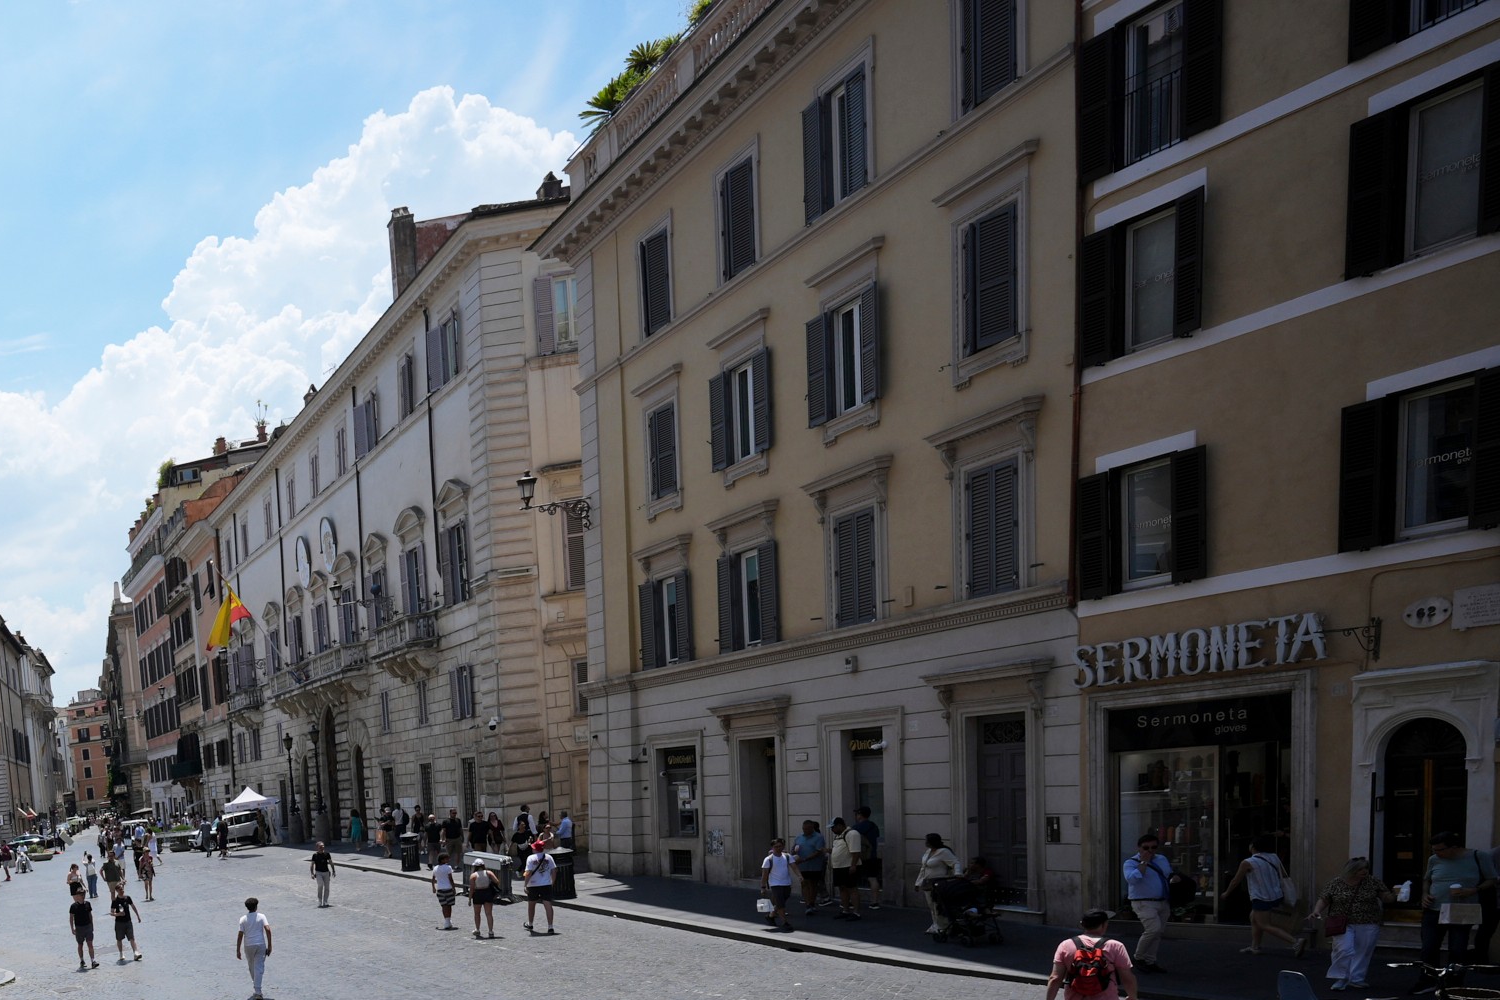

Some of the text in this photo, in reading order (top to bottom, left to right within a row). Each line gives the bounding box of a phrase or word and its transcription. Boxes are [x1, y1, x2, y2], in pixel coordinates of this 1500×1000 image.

[1416, 606, 1437, 619] 62
[1071, 612, 1328, 689] SERMONETA
[1136, 708, 1248, 729] Sermoneta
[1214, 723, 1248, 736] gloves
